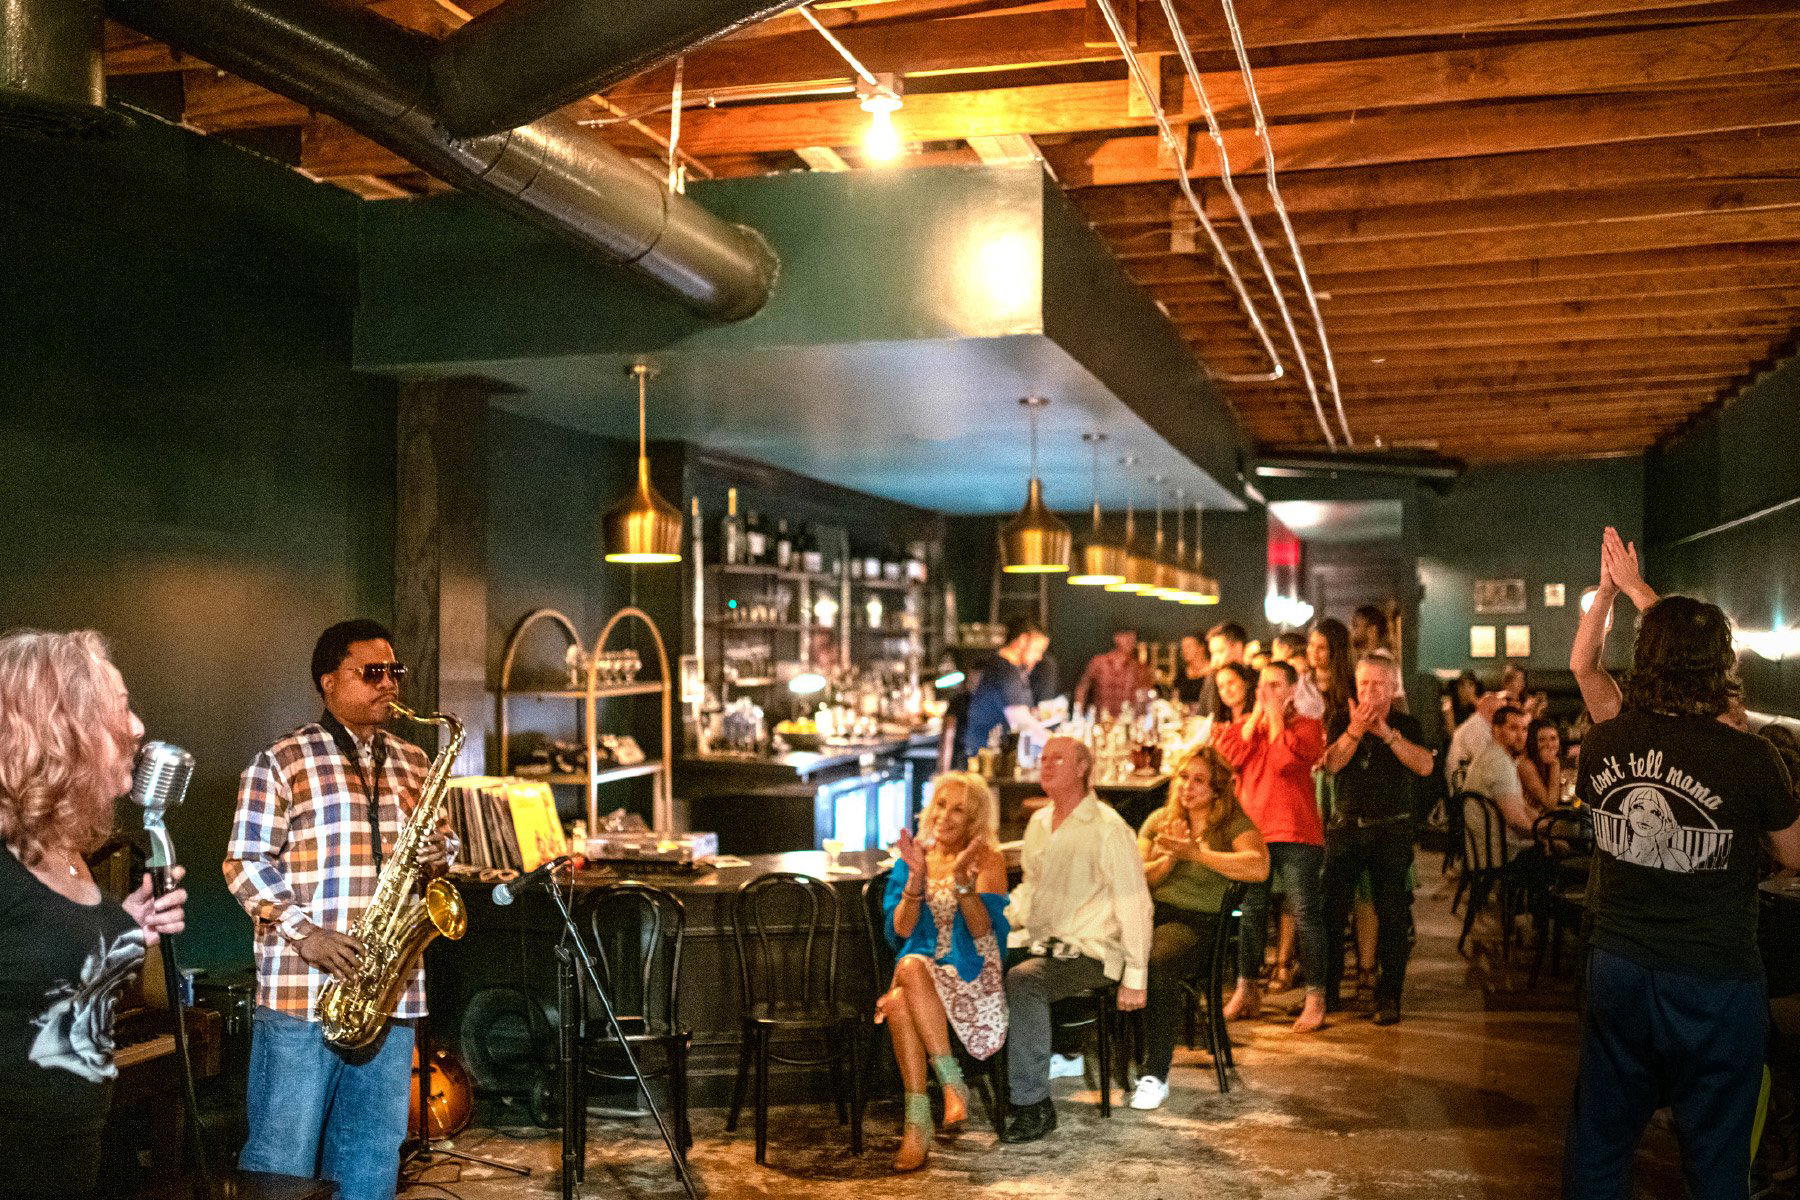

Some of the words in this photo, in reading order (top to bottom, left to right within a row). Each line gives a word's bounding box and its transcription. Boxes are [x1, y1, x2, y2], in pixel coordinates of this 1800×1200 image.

[1590, 755, 1625, 795] don't
[1628, 749, 1663, 779] tell
[1666, 766, 1724, 810] mama
